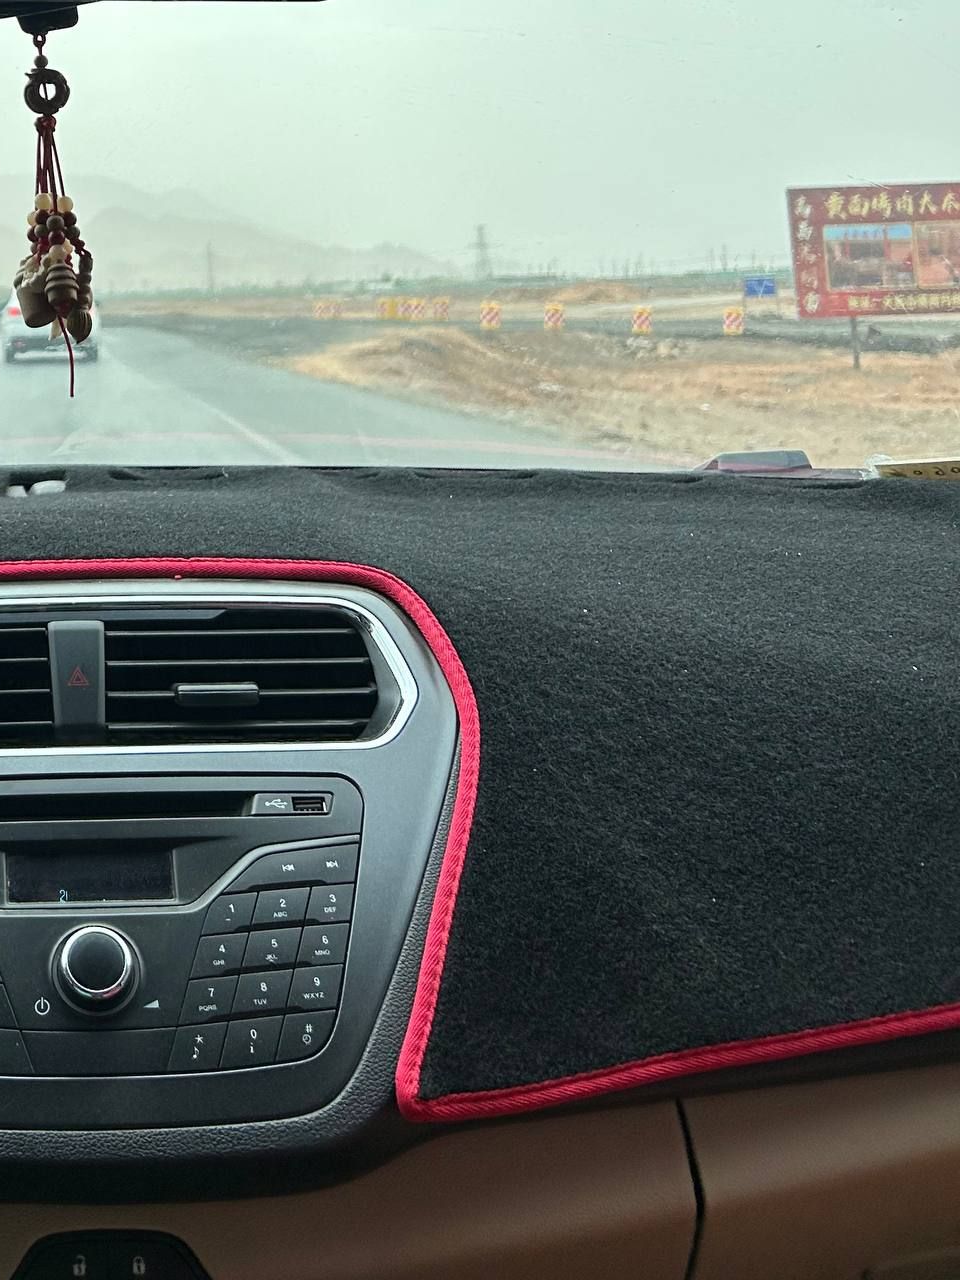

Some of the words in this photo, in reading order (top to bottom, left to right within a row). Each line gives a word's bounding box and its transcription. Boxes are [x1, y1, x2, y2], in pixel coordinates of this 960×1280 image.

[279, 898, 287, 908] 2
[329, 894, 337, 903] 3
[228, 903, 235, 913] 1
[271, 938, 279, 948] 5
[321, 935, 329, 945] 6
[218, 944, 226, 953] 4
[260, 982, 268, 992] 8
[313, 977, 321, 987] 9
[208, 987, 215, 998] 7
[303, 991, 325, 999] WXYZ
[250, 1029, 257, 1039] 0
